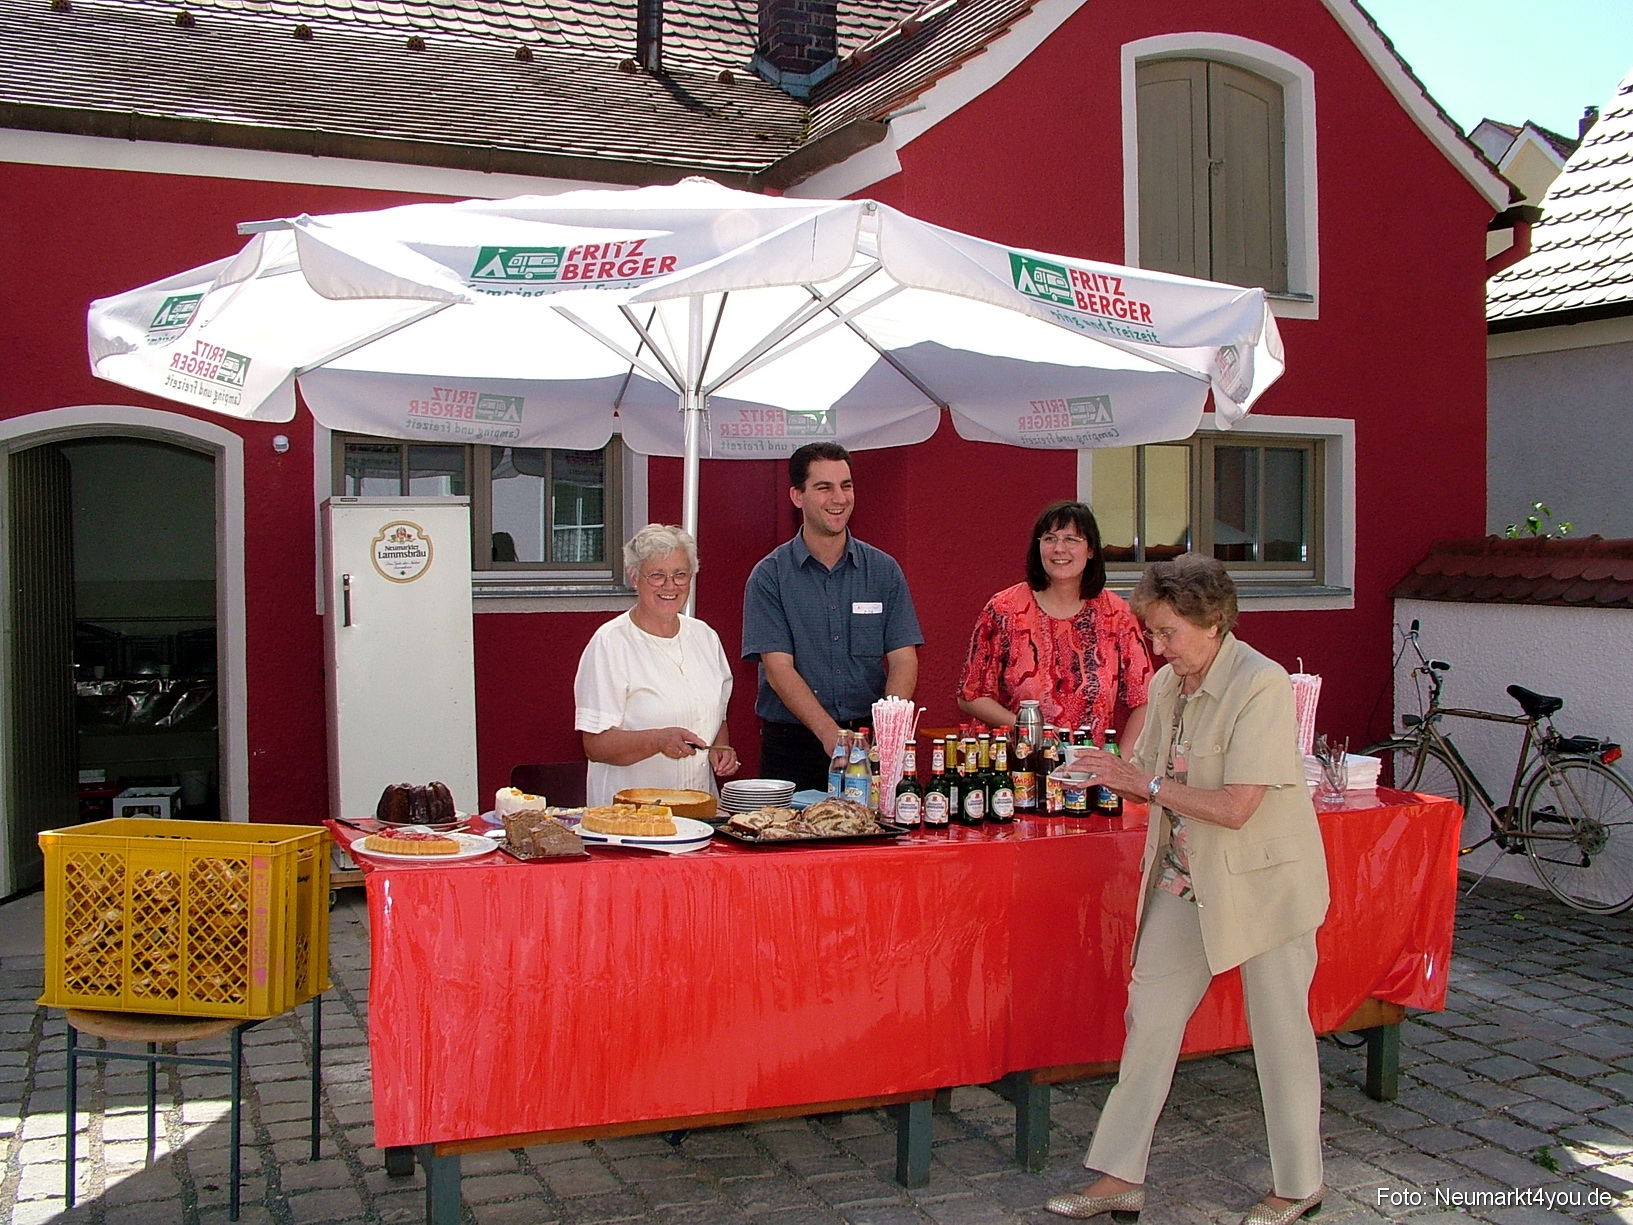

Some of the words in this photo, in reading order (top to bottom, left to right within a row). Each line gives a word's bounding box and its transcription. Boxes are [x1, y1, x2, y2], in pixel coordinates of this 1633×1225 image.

[567, 239, 647, 261] FRITZ
[561, 255, 677, 280] BERGER
[1069, 269, 1126, 296] FRITZ
[1075, 290, 1153, 324] BERGER
[1107, 321, 1161, 344] Freizeit
[378, 550, 427, 559] Lammsbräu
